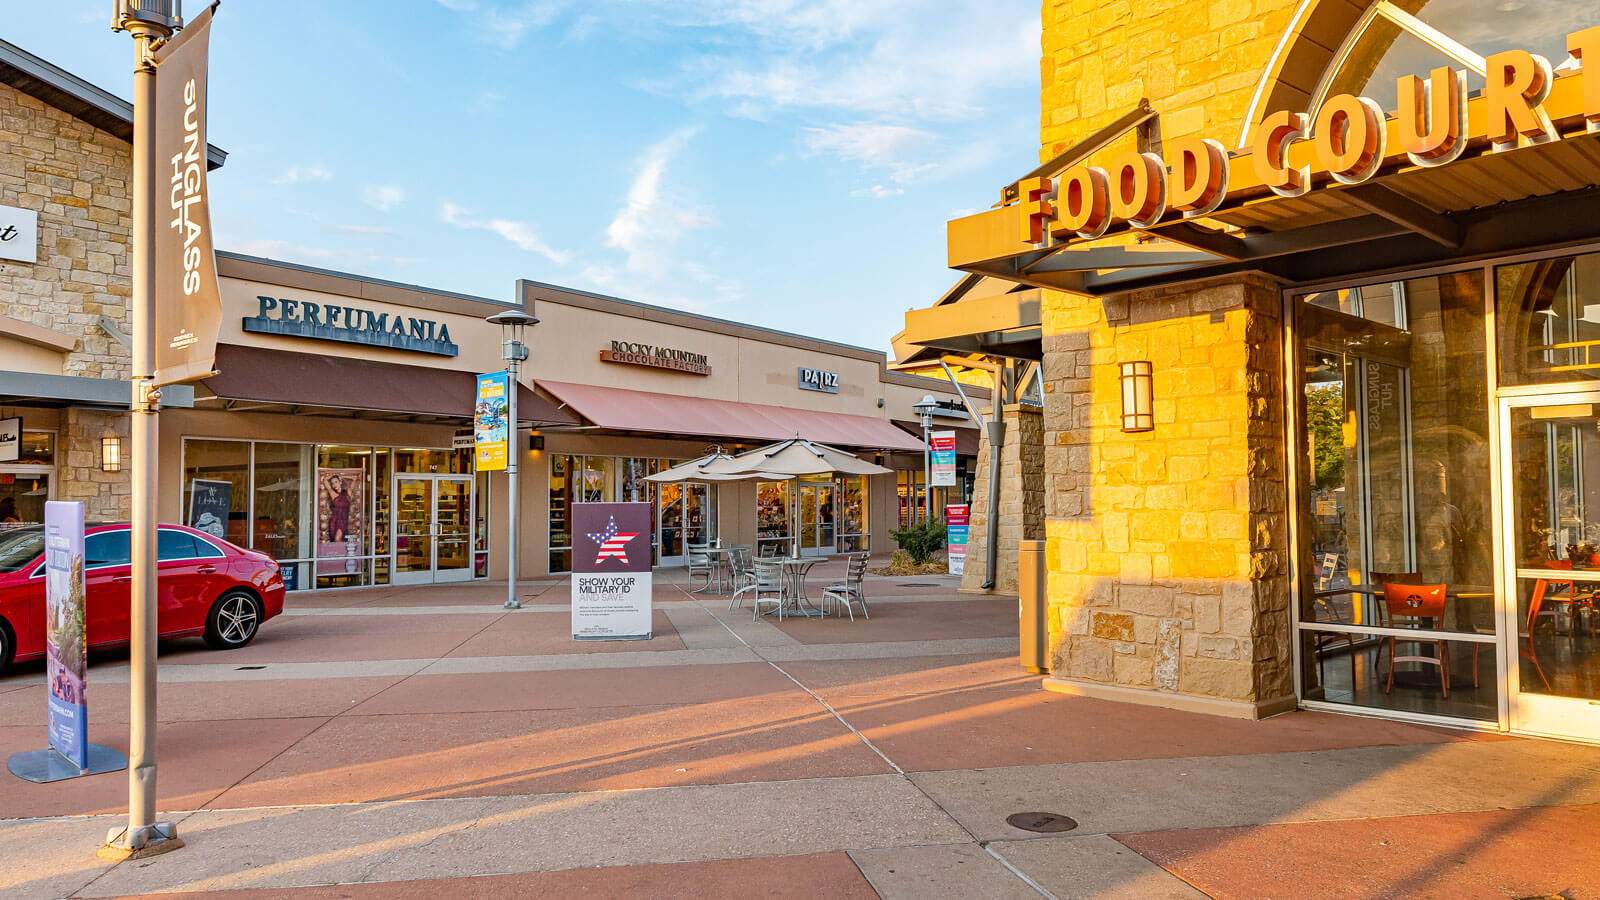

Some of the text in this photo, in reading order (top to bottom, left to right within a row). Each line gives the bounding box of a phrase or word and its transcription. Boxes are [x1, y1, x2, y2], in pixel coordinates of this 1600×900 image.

[1018, 26, 1600, 248] FOOD COURT
[170, 152, 183, 234] HUT
[183, 78, 202, 296] SUNGLASS
[256, 295, 451, 345] PERFUMANIA
[610, 340, 708, 366] ROCKY MOUNTAIN
[611, 352, 708, 374] CHOCOLATE FACTORY
[803, 369, 839, 389] PAIRZ
[579, 577, 635, 585] SHOW YOUR
[579, 586, 631, 594] MILITARY ID
